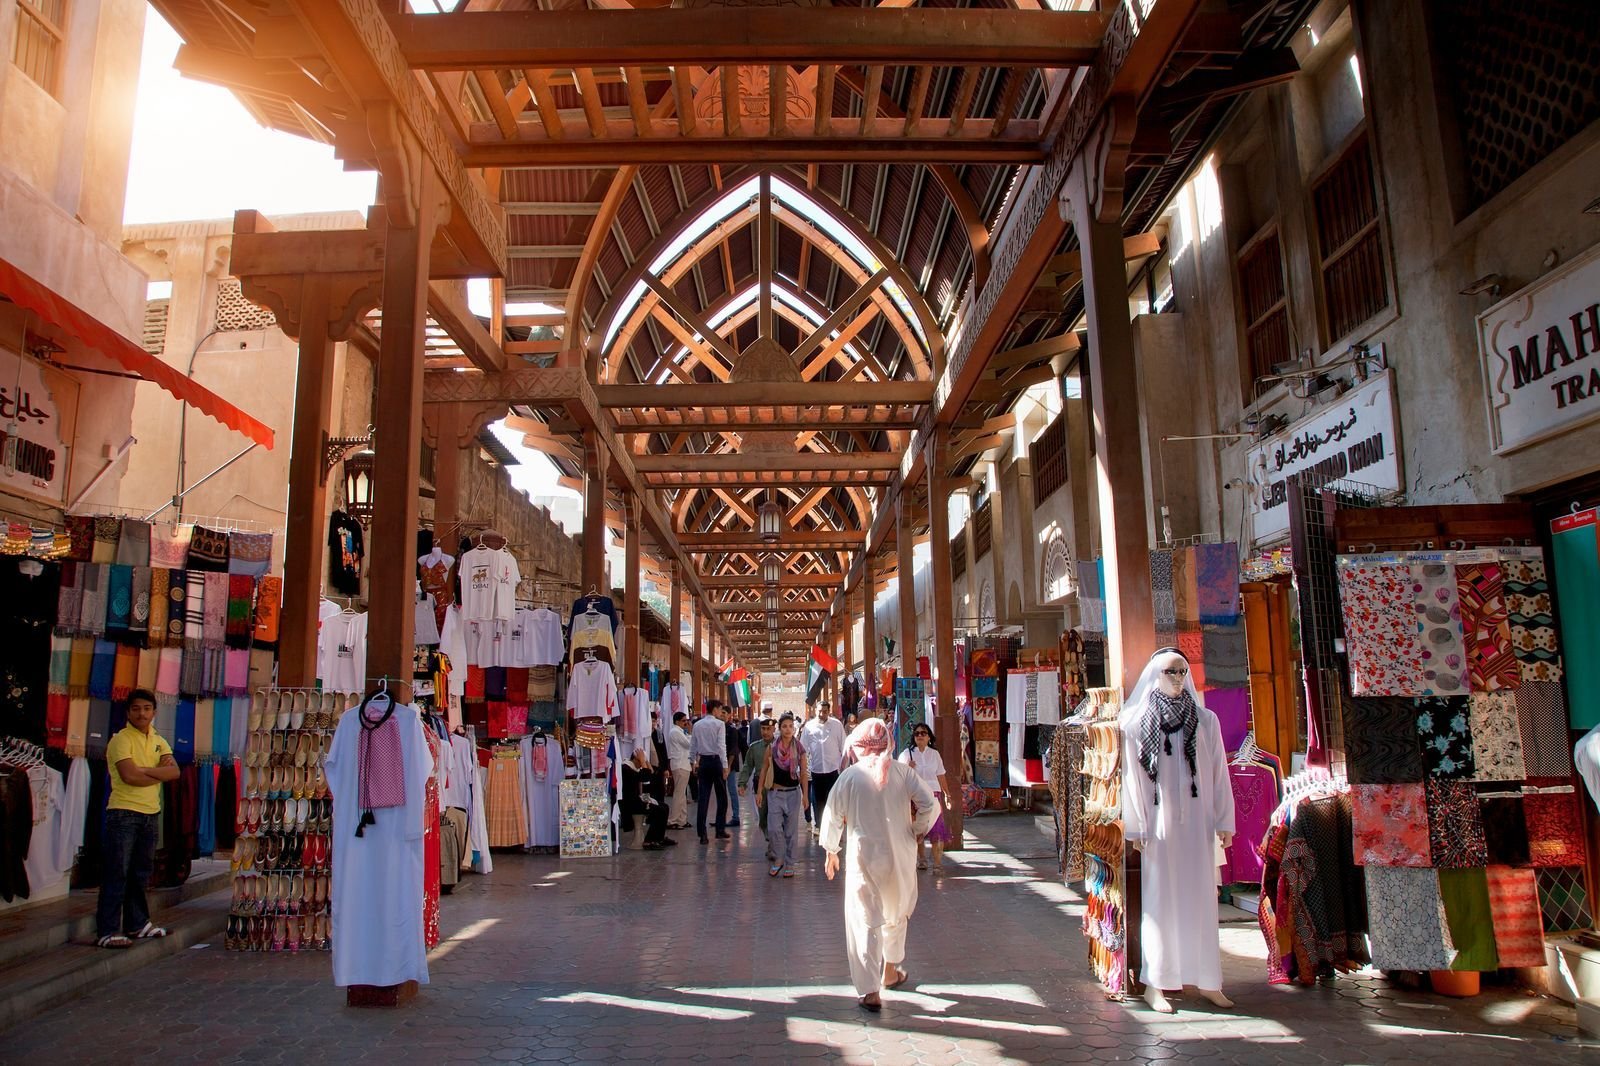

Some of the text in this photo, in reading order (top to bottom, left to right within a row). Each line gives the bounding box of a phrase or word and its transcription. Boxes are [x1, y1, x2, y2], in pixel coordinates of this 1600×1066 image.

[0, 430, 55, 482] TADING
[1262, 432, 1384, 510] SER HAMMAD KHAN
